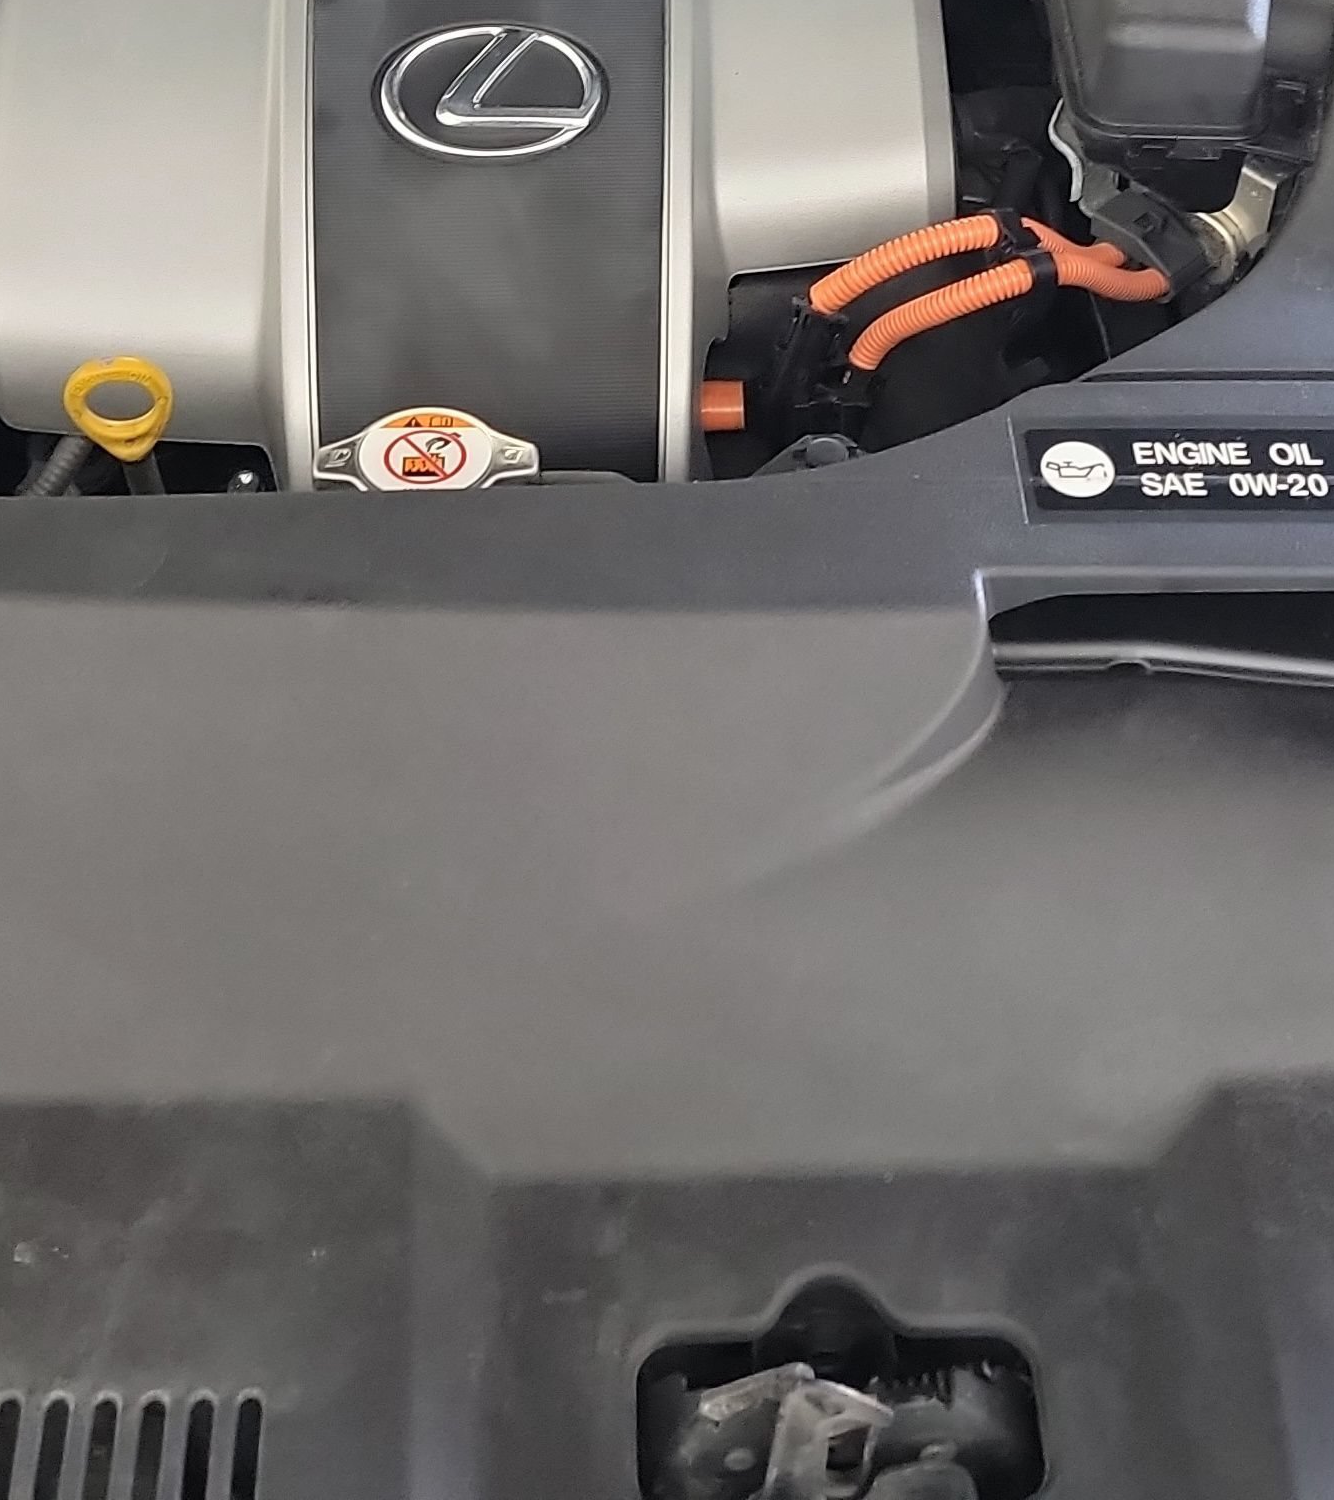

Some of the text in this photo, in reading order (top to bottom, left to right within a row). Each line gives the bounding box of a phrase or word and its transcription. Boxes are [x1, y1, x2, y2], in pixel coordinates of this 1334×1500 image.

[1131, 442, 1324, 466] ENGINE OIL
[1139, 472, 1329, 497] SAE 0W-20
